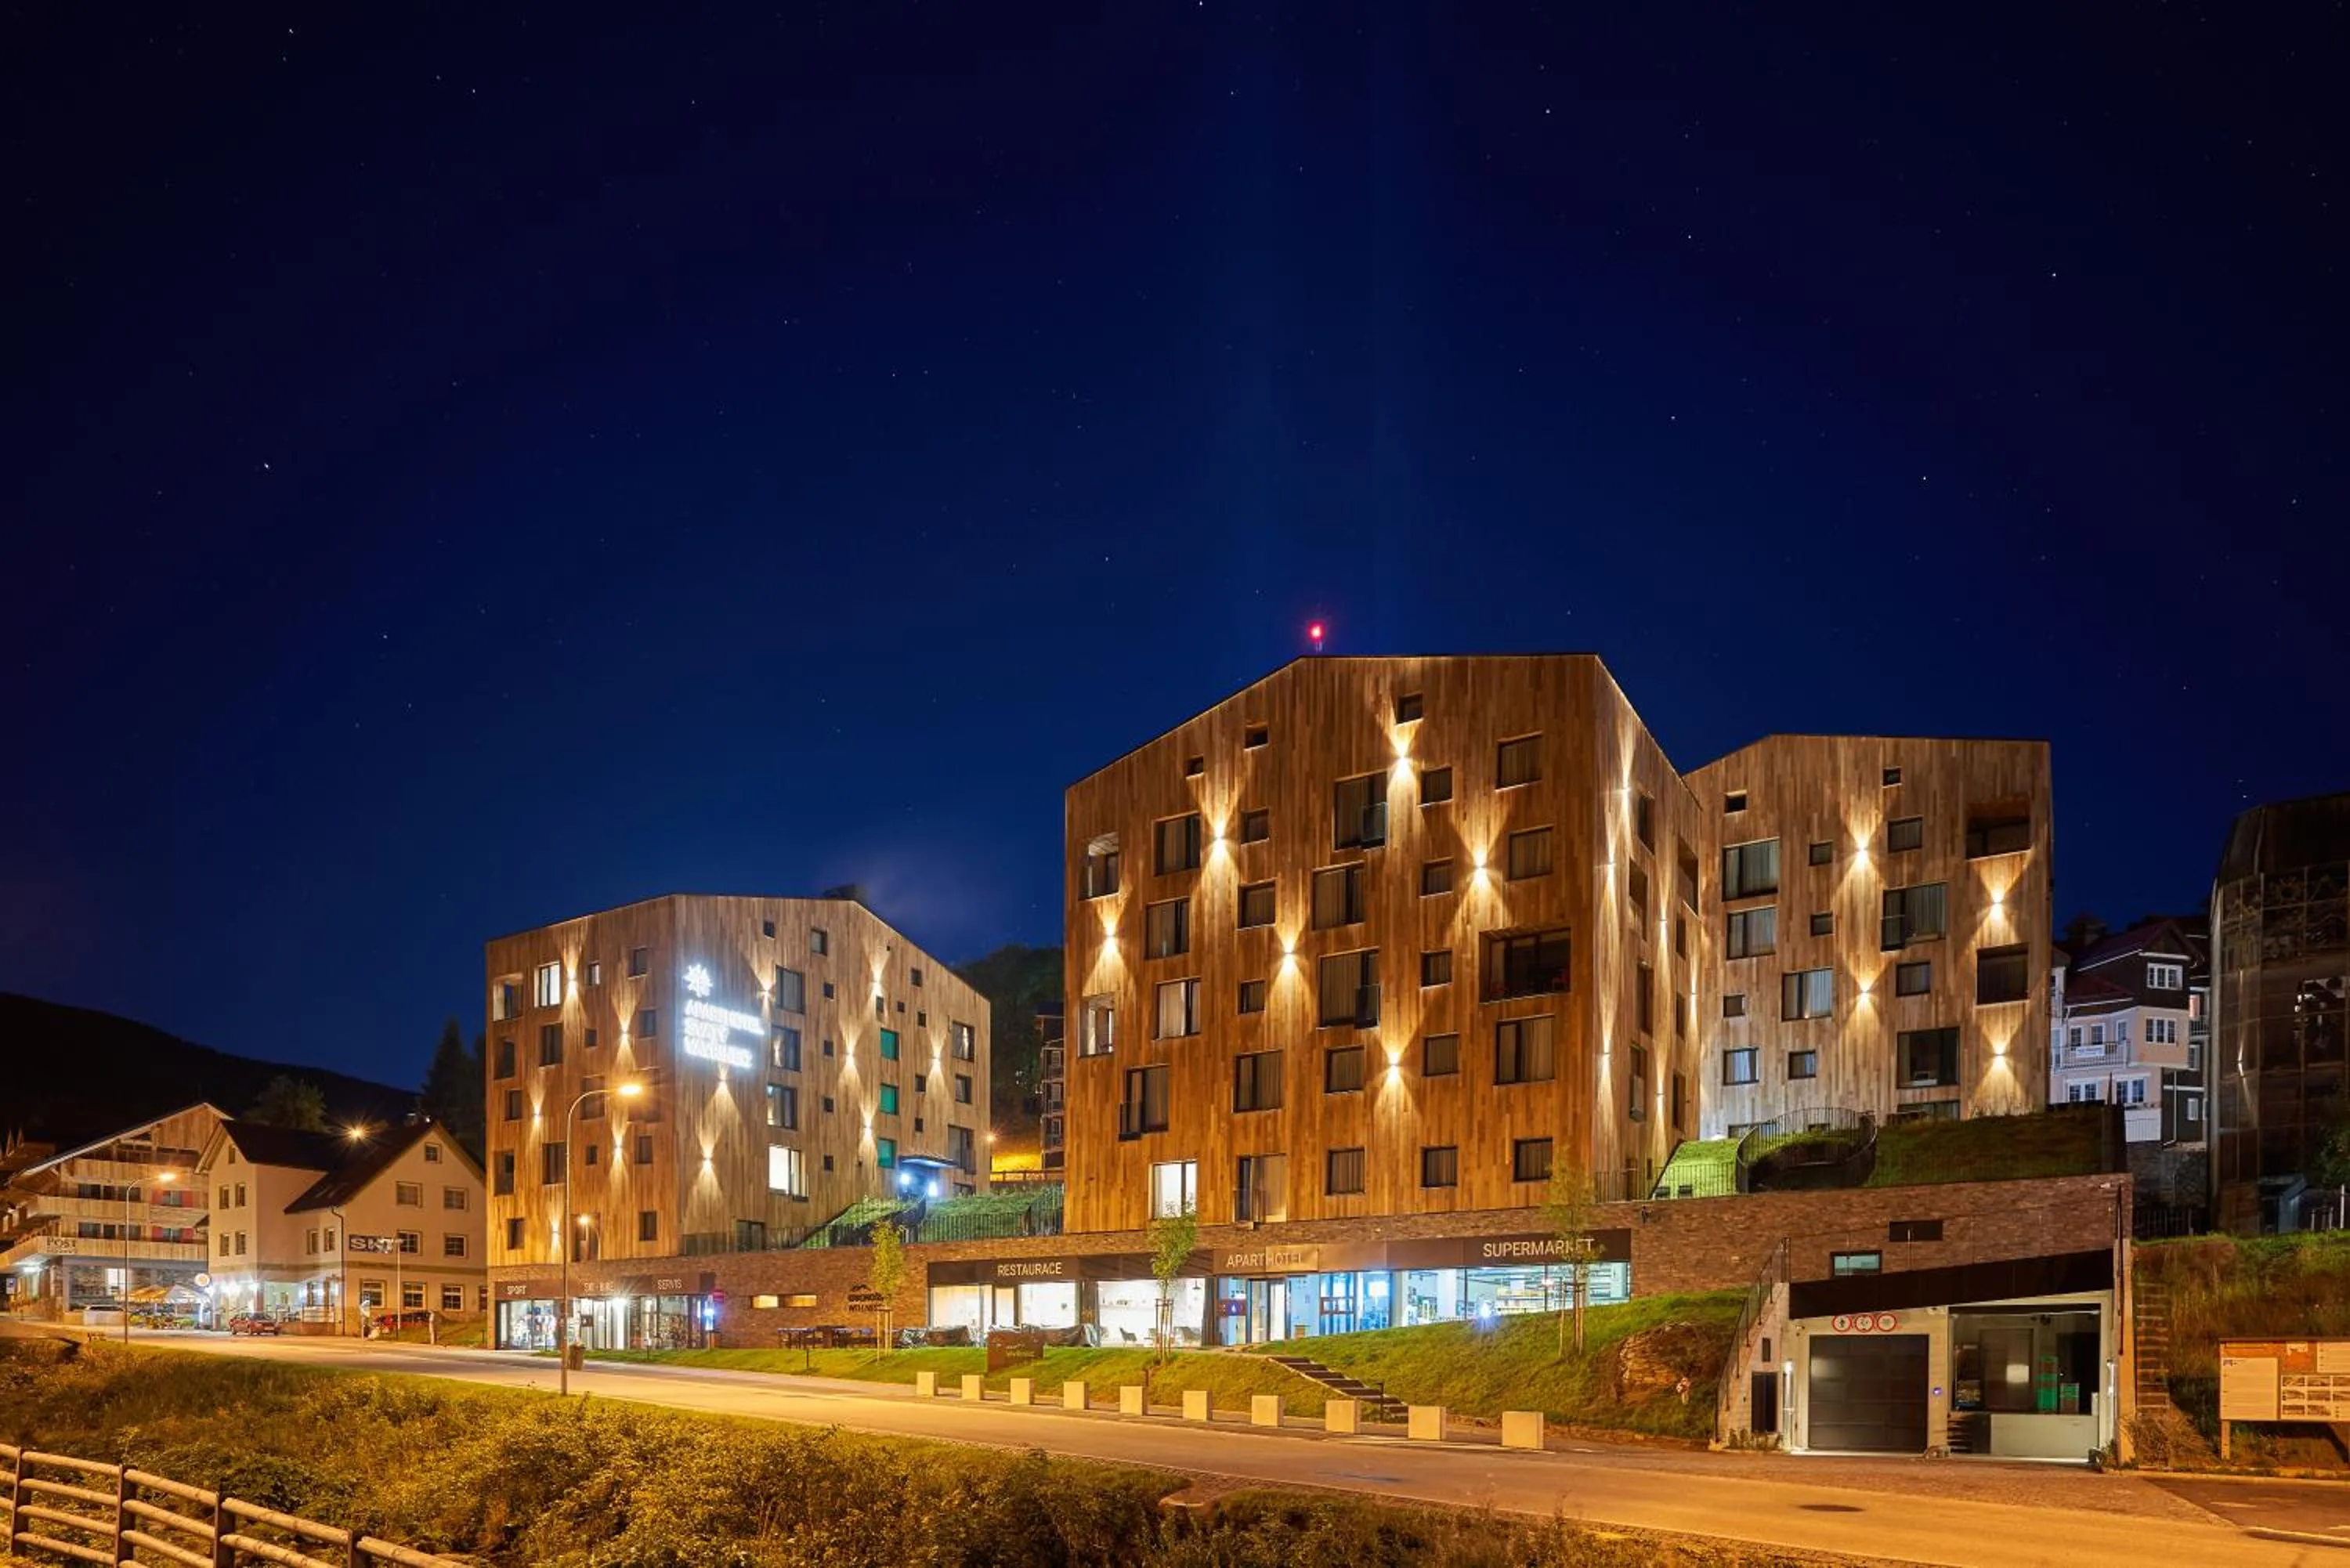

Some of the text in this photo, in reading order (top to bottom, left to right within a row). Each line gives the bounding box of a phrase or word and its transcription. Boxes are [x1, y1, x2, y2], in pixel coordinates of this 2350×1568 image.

[1483, 1238, 1595, 1257] SUPERMARKET
[1226, 1252, 1301, 1268] APARTHOTEL
[997, 1262, 1062, 1277] RESTAURACE
[507, 1285, 526, 1295] SPORT
[658, 1278, 682, 1290] SERVIS
